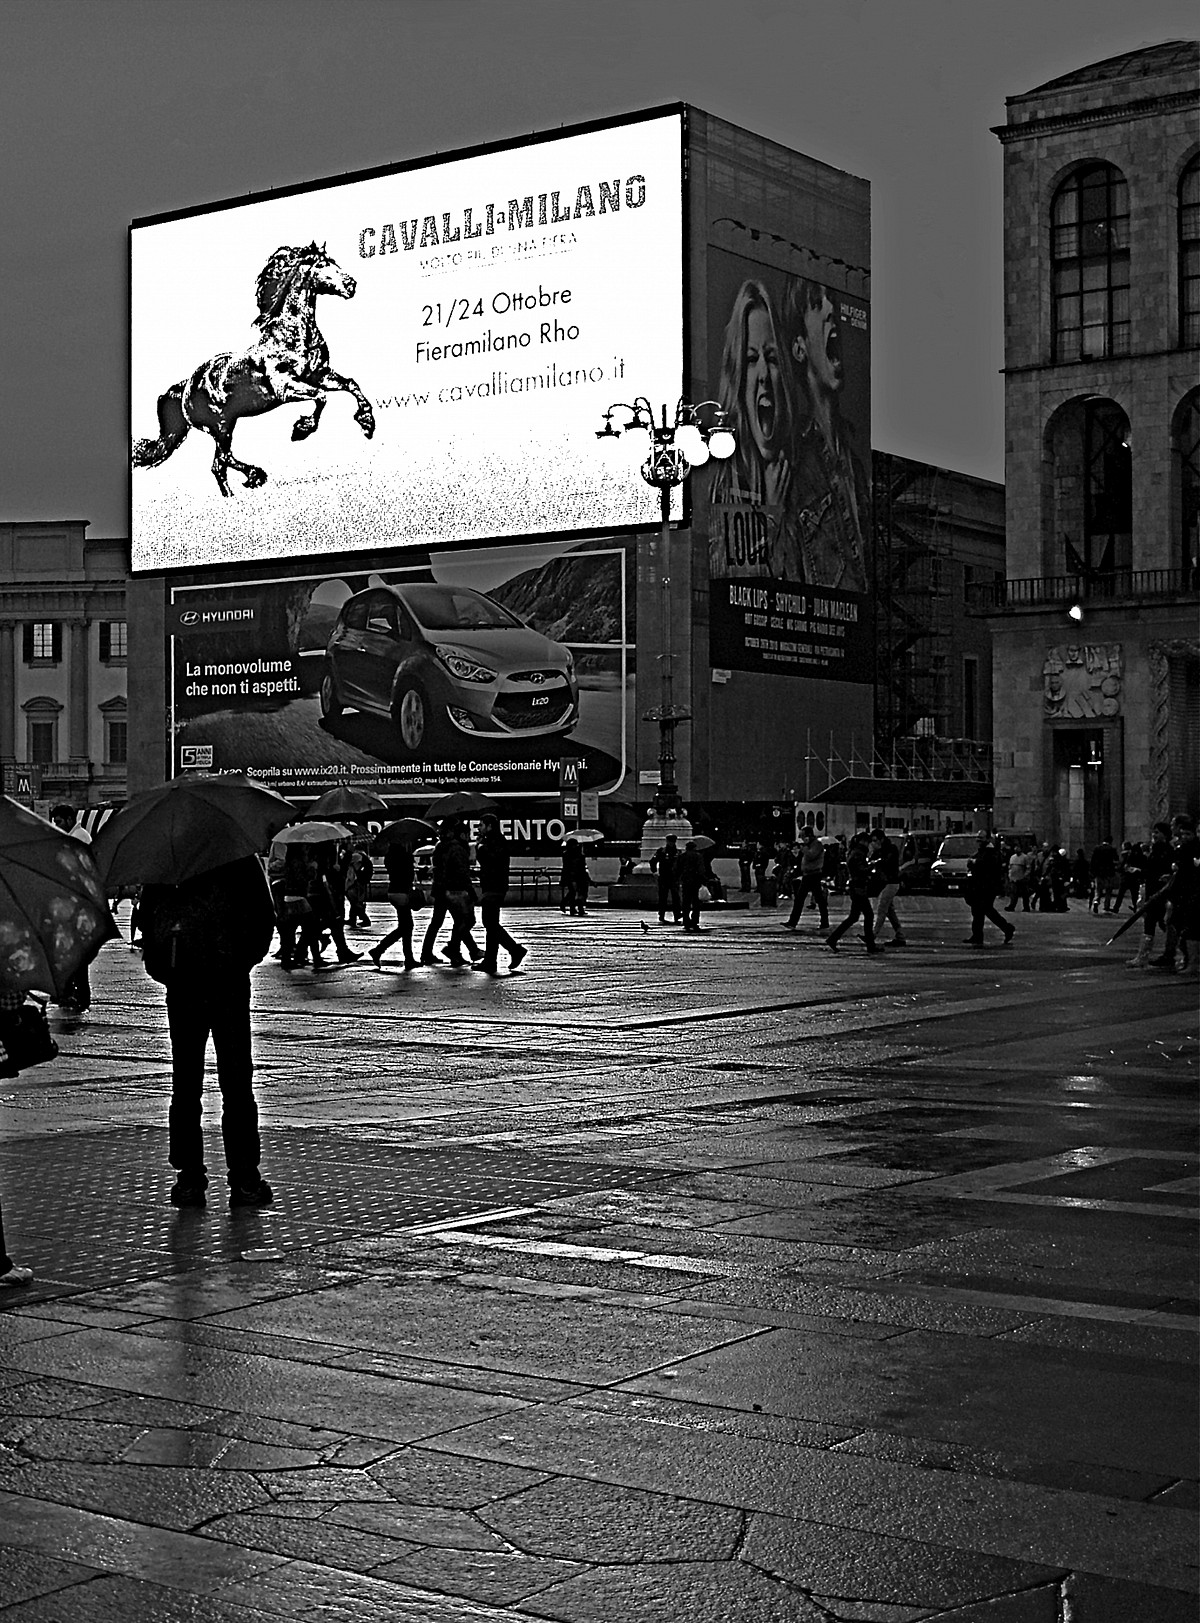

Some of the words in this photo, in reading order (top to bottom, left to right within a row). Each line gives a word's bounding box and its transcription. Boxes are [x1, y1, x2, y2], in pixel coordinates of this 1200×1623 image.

[358, 203, 495, 258] CAVALLI
[507, 174, 647, 231] MILANO
[421, 298, 484, 328] 21/24
[492, 284, 572, 314] Ottobre
[416, 329, 531, 364] Fieramilano
[540, 318, 580, 344] Rho
[729, 584, 752, 608] BLACK
[753, 588, 768, 610] LIPS
[813, 597, 829, 618] JUAN
[830, 600, 858, 622] MACLEAN
[202, 609, 254, 623] HYUNDAI
[186, 662, 201, 677] La
[204, 658, 292, 676] monovolume
[186, 682, 209, 696] che
[211, 683, 237, 696] non
[240, 679, 250, 694] ti
[252, 676, 302, 697] aspetti.
[184, 749, 196, 764] 5
[246, 766, 281, 779] Scoprila
[282, 768, 292, 777] su
[294, 765, 349, 776] www.ix20.it.
[350, 763, 421, 774] Prossimamente
[422, 762, 432, 772] in
[433, 762, 456, 772] tutte
[458, 761, 467, 771] le
[468, 760, 542, 772] Concessionarie
[543, 758, 588, 772] Hyuai.
